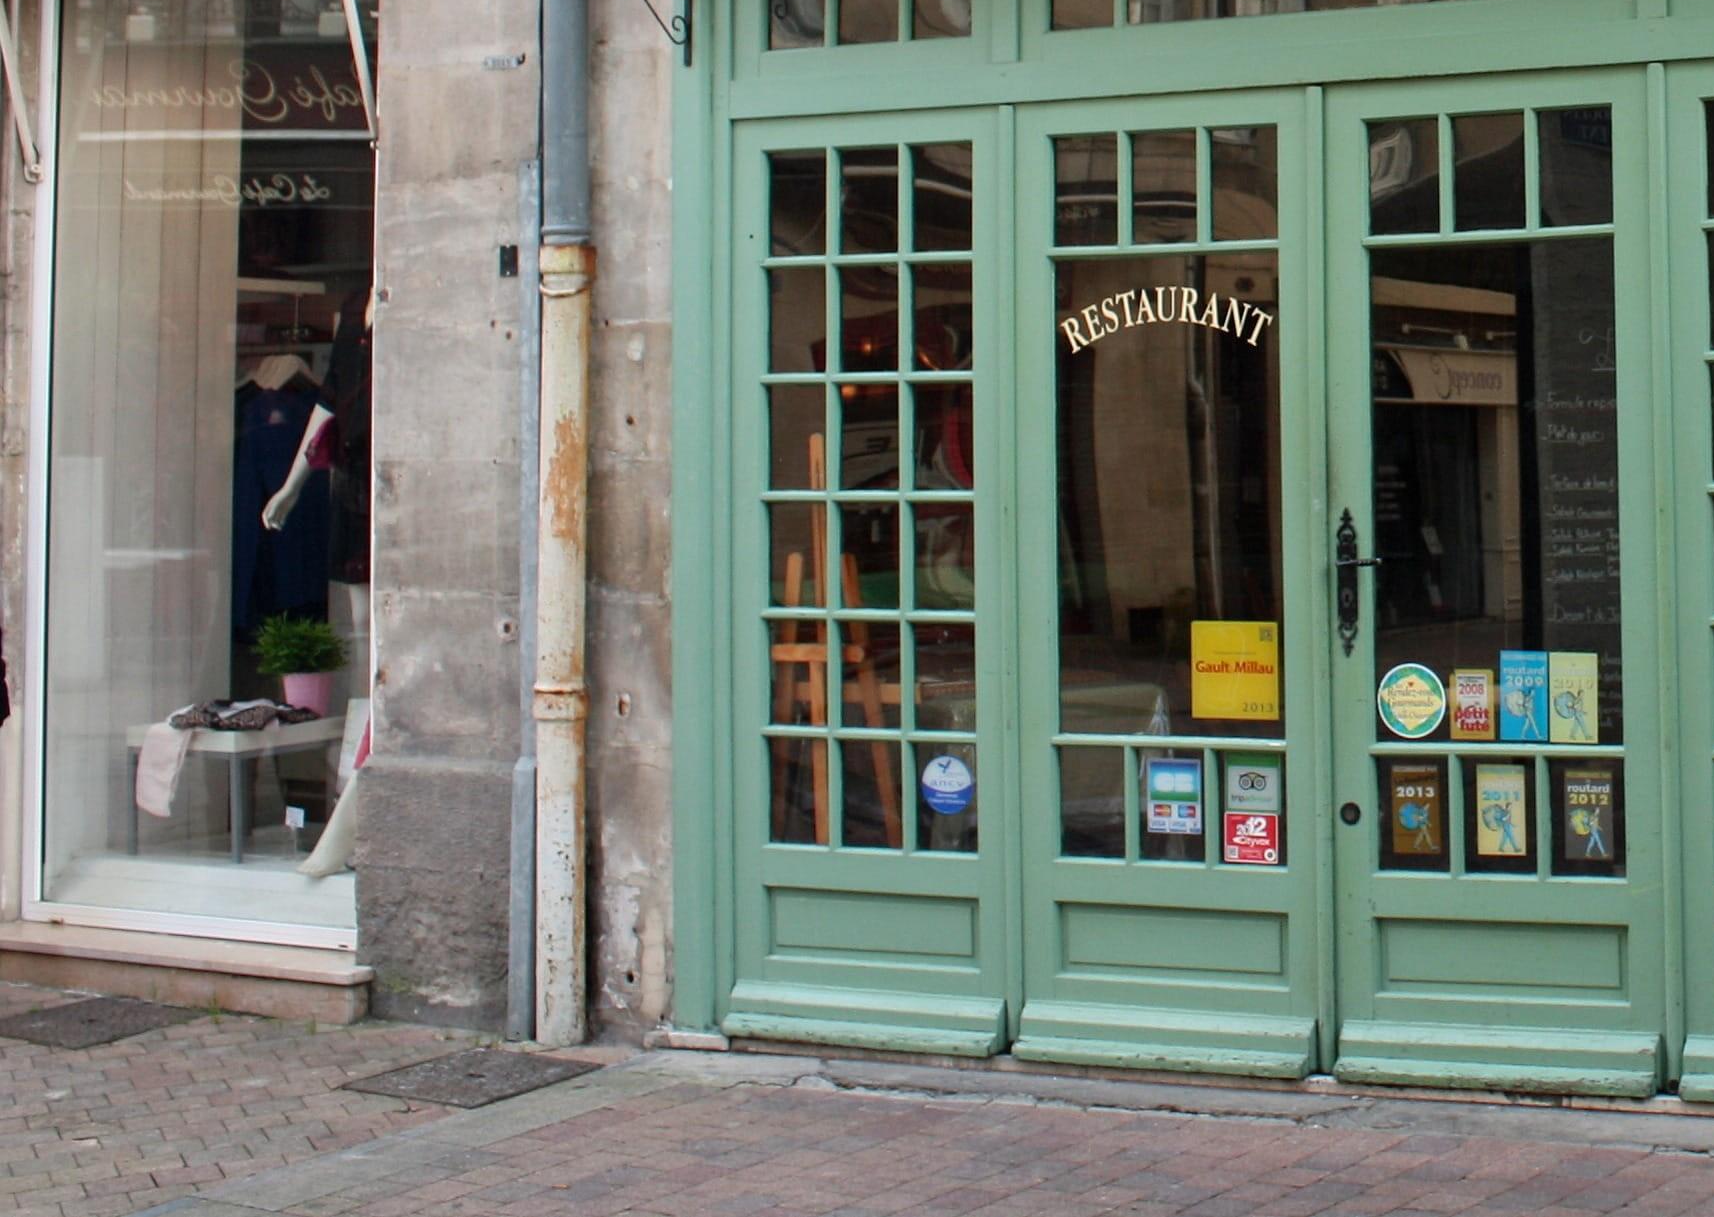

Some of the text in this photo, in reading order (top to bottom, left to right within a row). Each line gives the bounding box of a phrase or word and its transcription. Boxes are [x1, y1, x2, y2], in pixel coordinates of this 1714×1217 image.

[1060, 285, 1274, 354] RESTAURANT
[1196, 660, 1274, 675] Gault Millau
[1504, 675, 1544, 687] 2009
[1459, 684, 1484, 695] 2008
[1396, 786, 1435, 798] 2013
[1568, 794, 1609, 806] 2012
